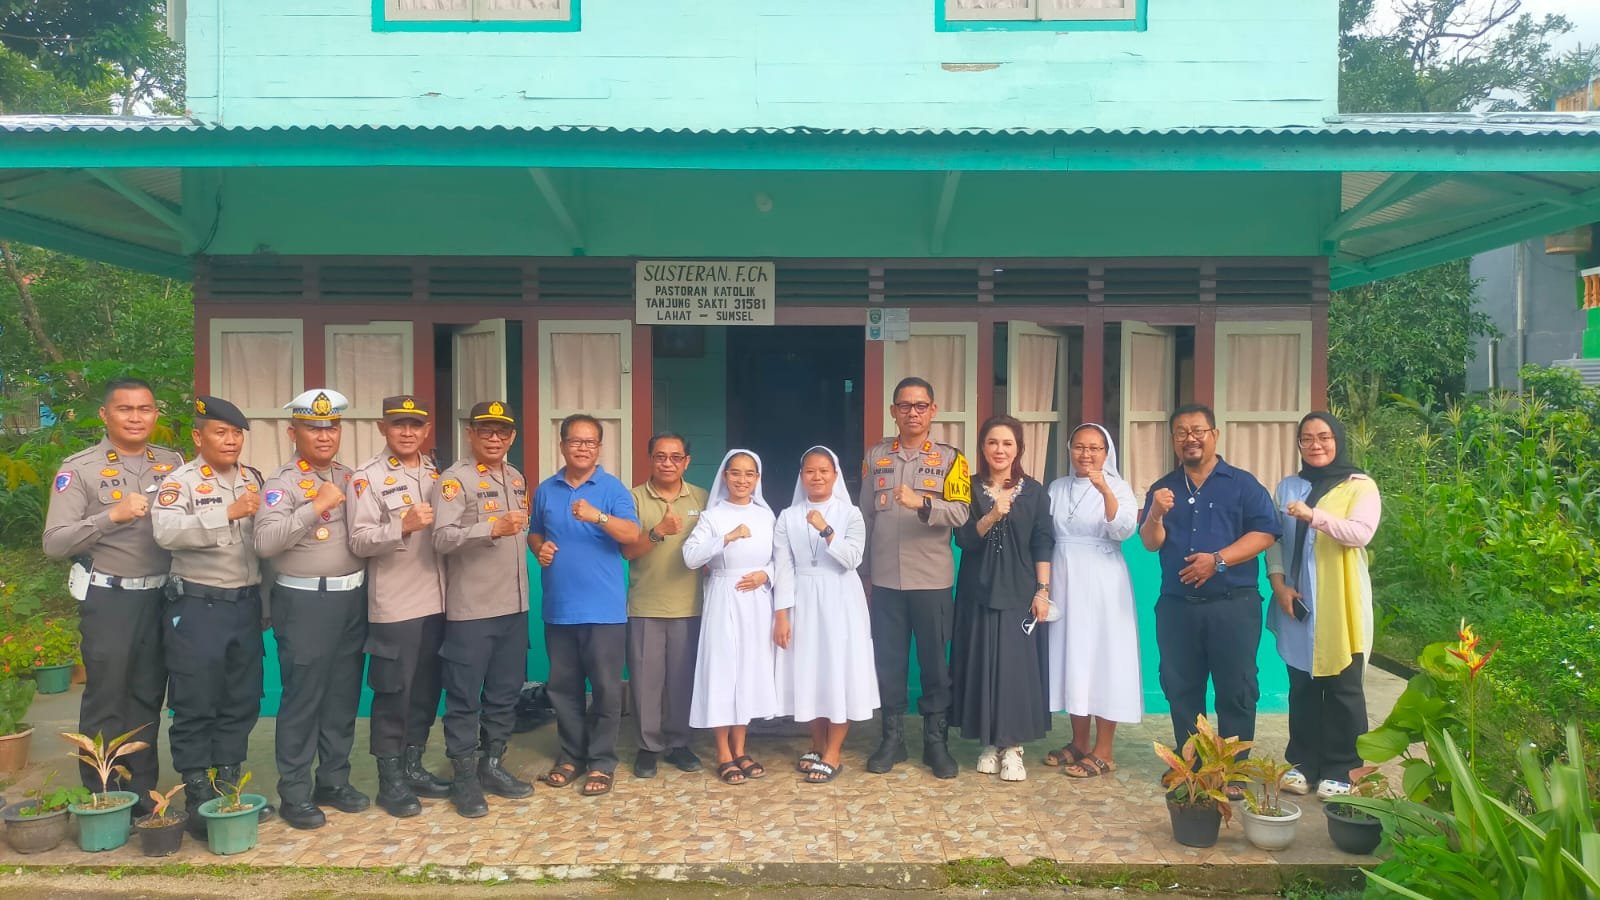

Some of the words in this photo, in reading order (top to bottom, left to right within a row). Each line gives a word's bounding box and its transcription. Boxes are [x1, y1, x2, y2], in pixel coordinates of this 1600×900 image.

[655, 285, 708, 297] PASTORAN
[713, 286, 756, 297] KATOLIK
[645, 297, 691, 309] TANJUNG
[697, 298, 728, 309] SAKTI
[734, 298, 767, 310] 31581
[657, 310, 692, 321] LAHAT
[716, 310, 754, 322] SUMSEL
[918, 467, 944, 477] POLRI
[950, 481, 961, 496] KA
